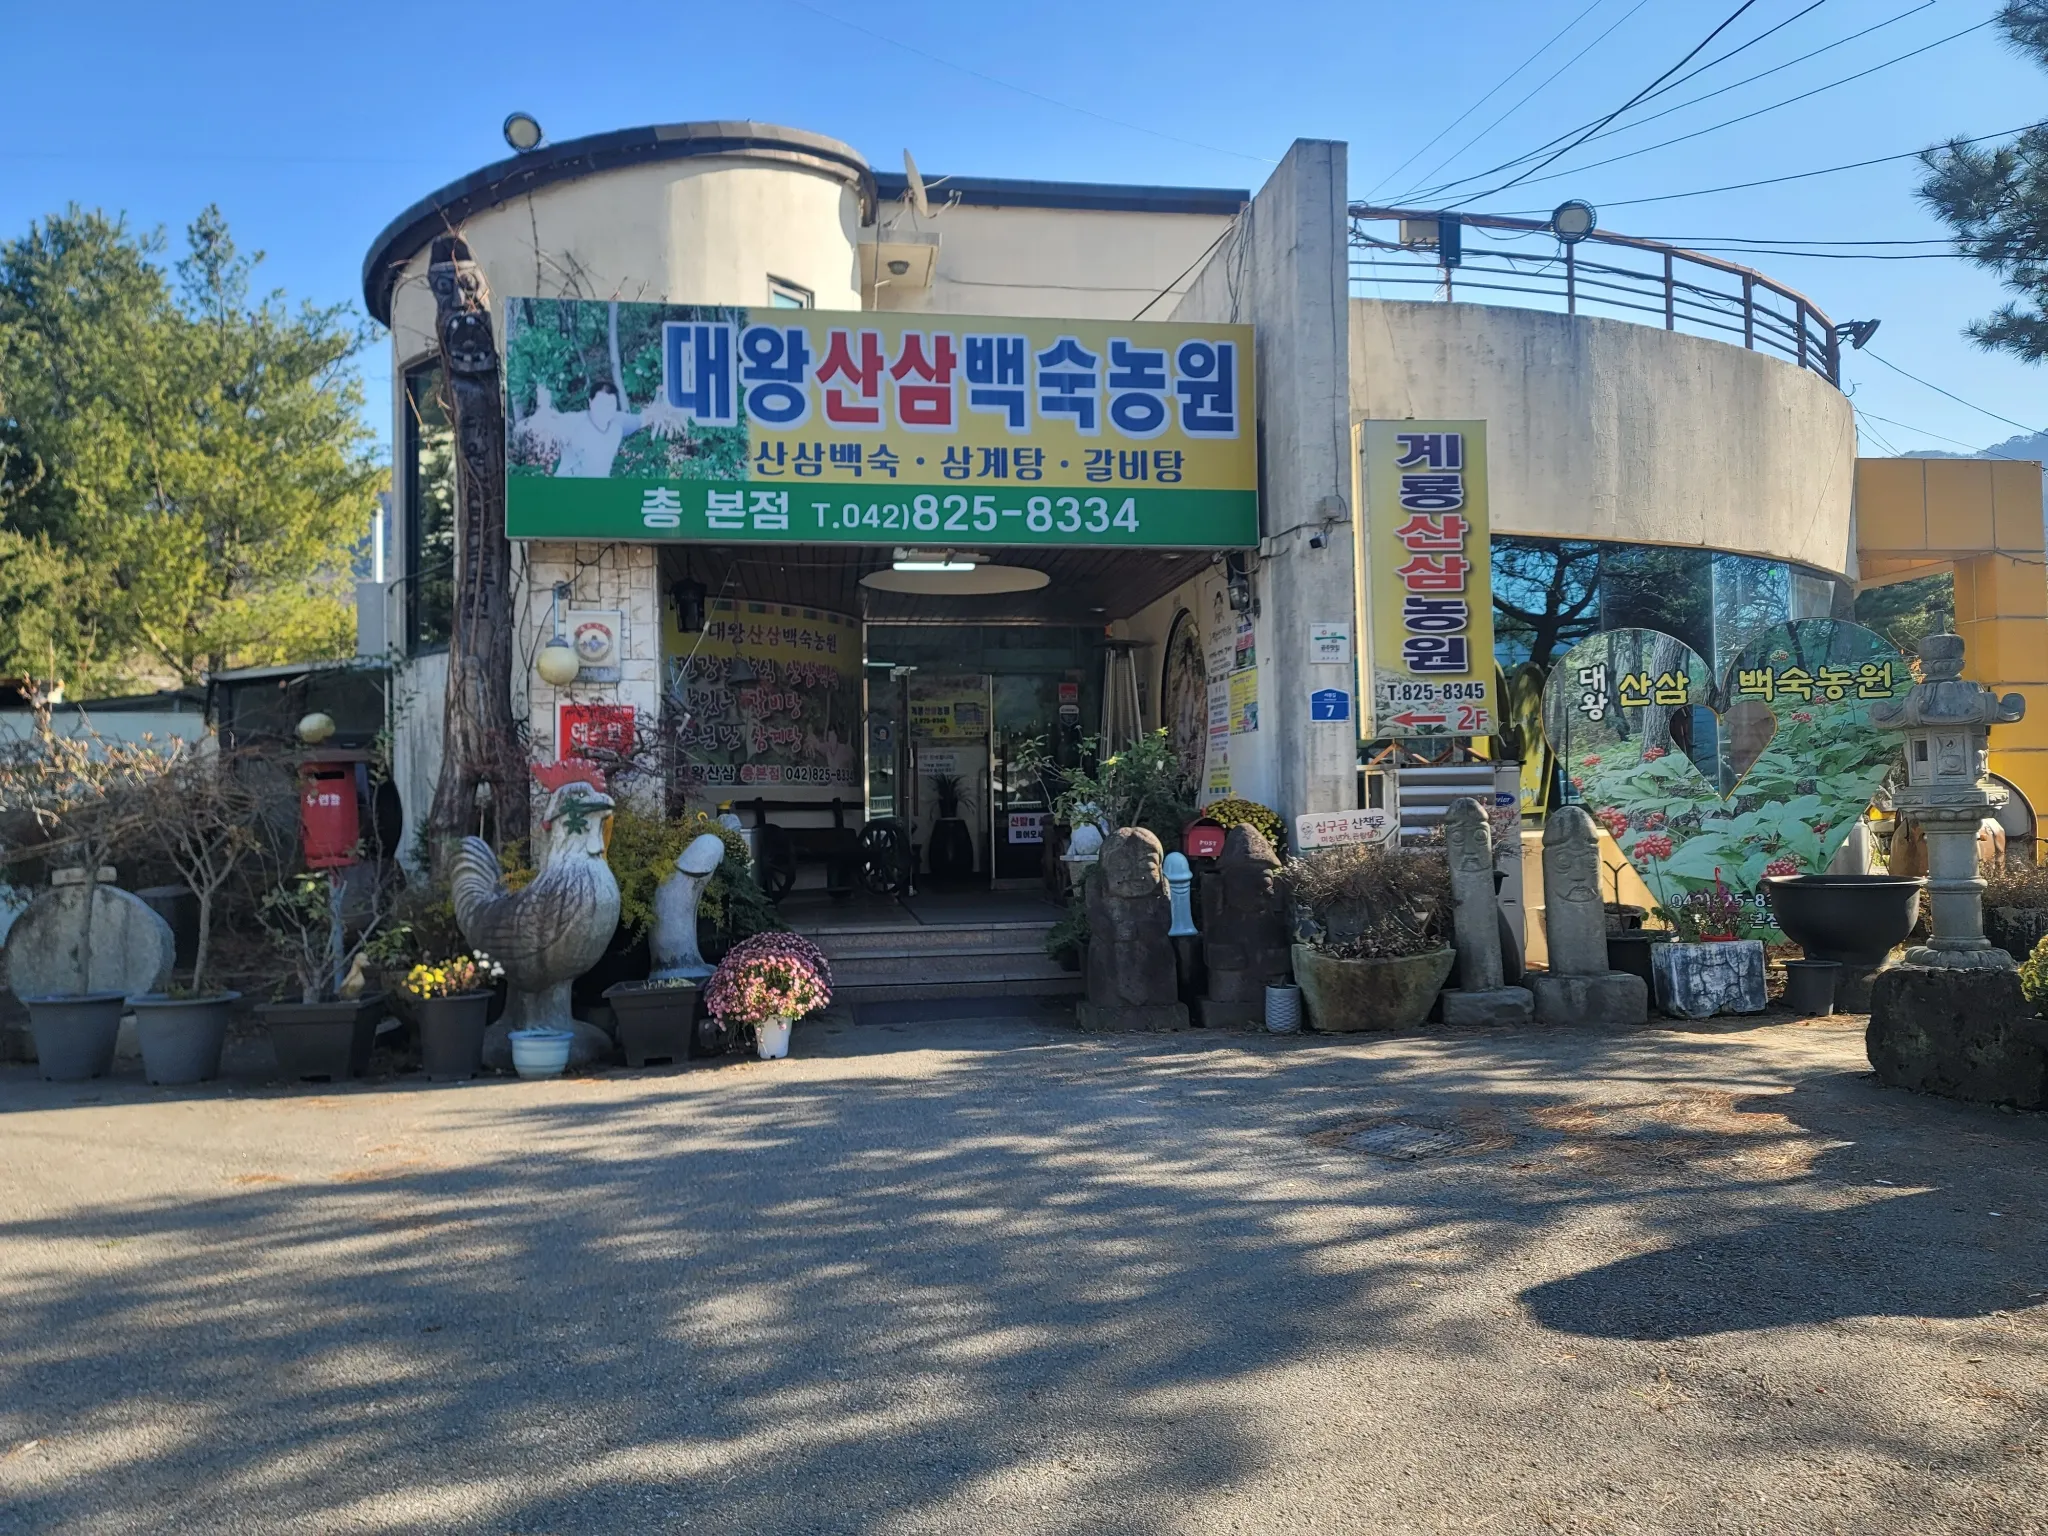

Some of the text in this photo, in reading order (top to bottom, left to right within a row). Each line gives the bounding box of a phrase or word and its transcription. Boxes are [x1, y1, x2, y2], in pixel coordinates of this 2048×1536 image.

[664, 322, 1238, 437] 대왕산삼백숙농원
[754, 441, 1185, 484] 산삼백숙 삼계탕 갈비탕
[640, 488, 1140, 534] 총 본점 T.042)825-8334
[1396, 432, 1469, 674] 계룡산삼농원
[708, 620, 838, 653] 대왕산삼백숙농원
[750, 689, 802, 720] 갈비탕
[1387, 682, 1485, 701] T.825-8345
[1578, 661, 1895, 721] 대왕 산삼 백숙농원
[1325, 705, 1335, 718] 7
[1457, 706, 1489, 731] 2F
[750, 724, 803, 753] 삼계탕
[1315, 819, 1349, 834] 십구금
